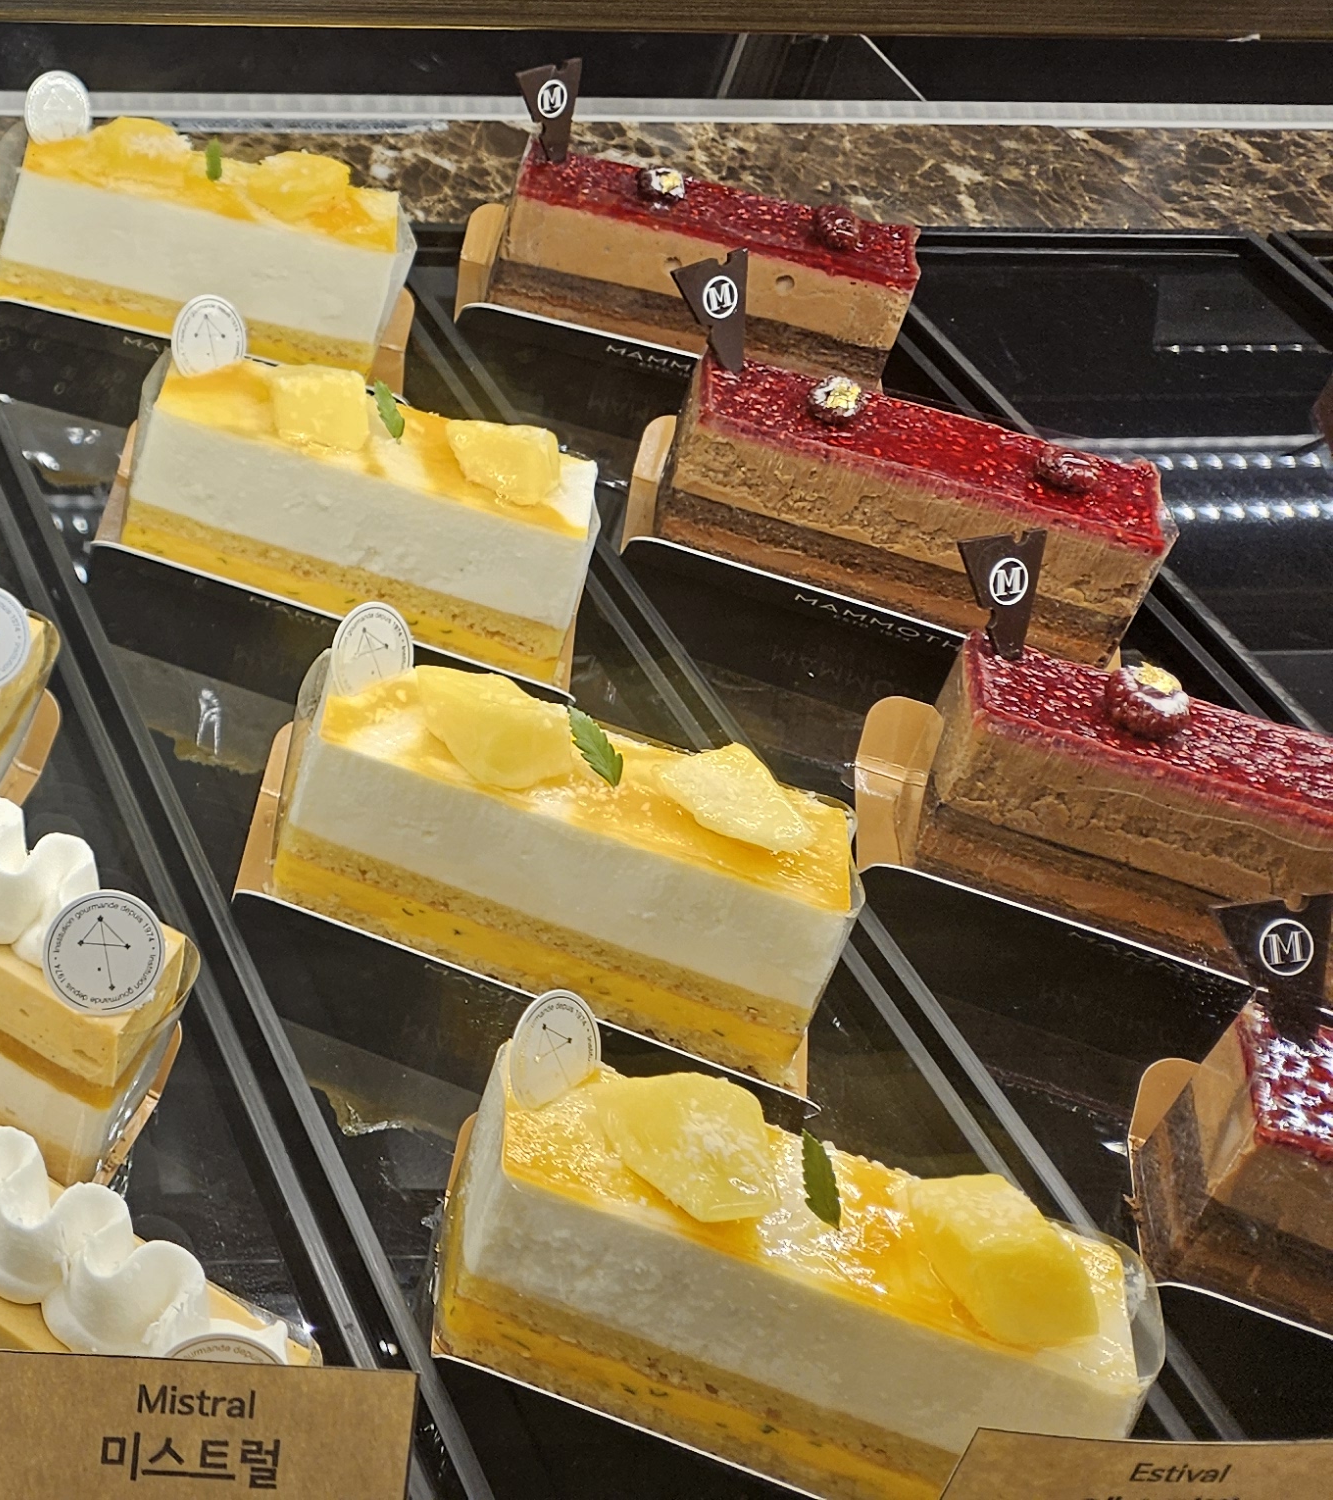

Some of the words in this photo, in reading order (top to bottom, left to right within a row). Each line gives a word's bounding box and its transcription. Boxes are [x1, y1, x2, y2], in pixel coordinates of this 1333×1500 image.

[605, 344, 691, 372] MAMM
[794, 593, 965, 652] MAMMOTH
[75, 902, 119, 919] gourmande
[120, 905, 143, 923] depuis
[143, 923, 155, 942] 1974
[54, 963, 67, 983] 1974
[65, 983, 88, 1001] depuis
[136, 1382, 256, 1419] Mistral
[100, 1432, 281, 1490] 미스트럴
[1128, 1462, 1232, 1483] Estival
